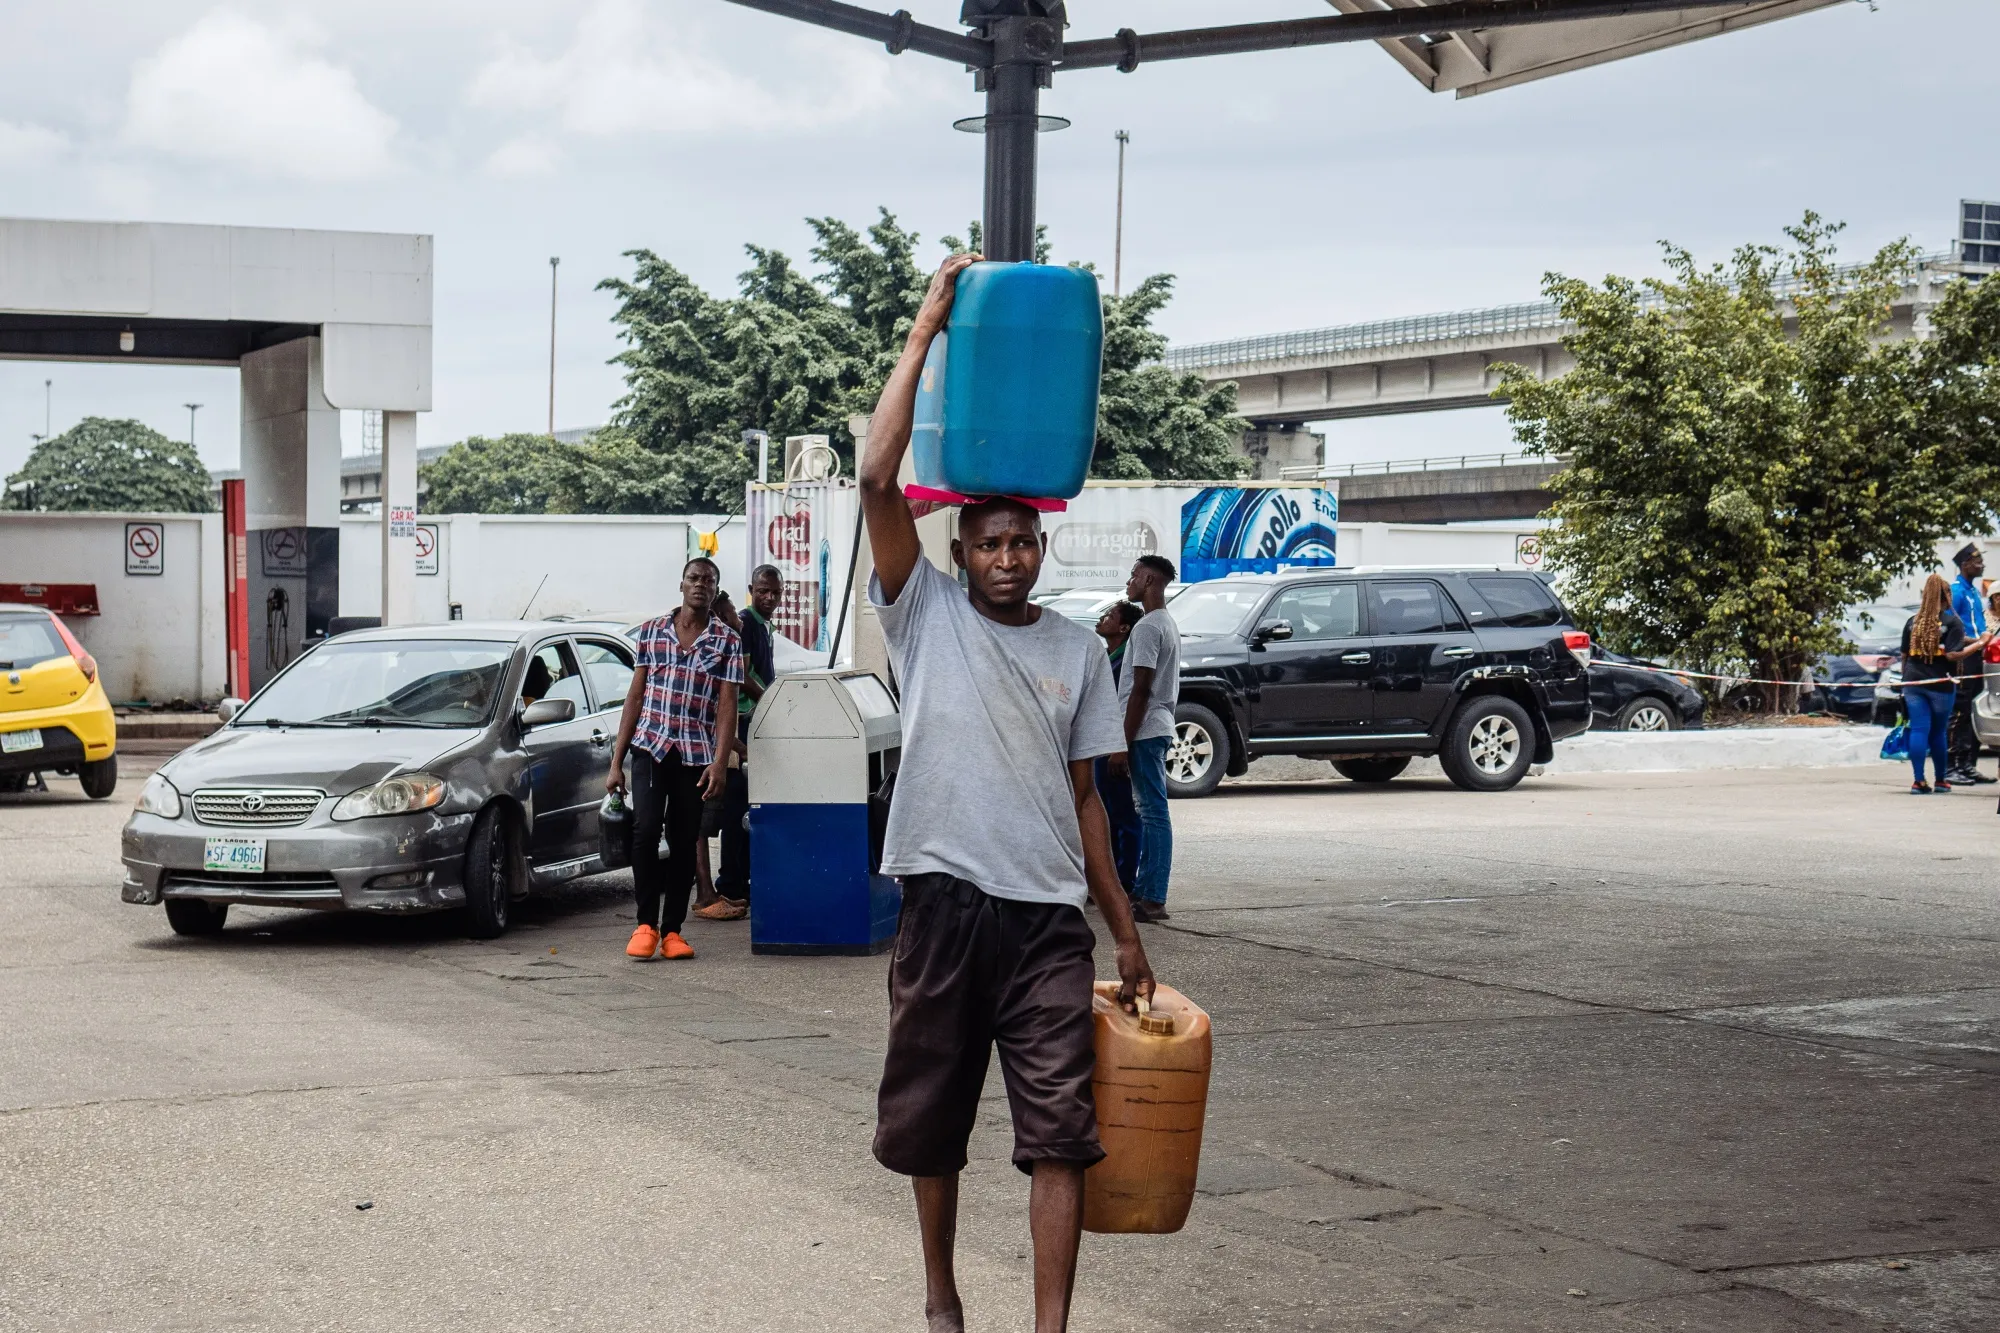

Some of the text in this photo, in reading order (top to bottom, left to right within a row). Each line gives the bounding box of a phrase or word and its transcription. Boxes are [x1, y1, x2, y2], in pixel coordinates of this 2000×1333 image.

[391, 511, 415, 521] CAR AC
[1061, 529, 1149, 553] moragoff
[1105, 570, 1119, 578] LTD
